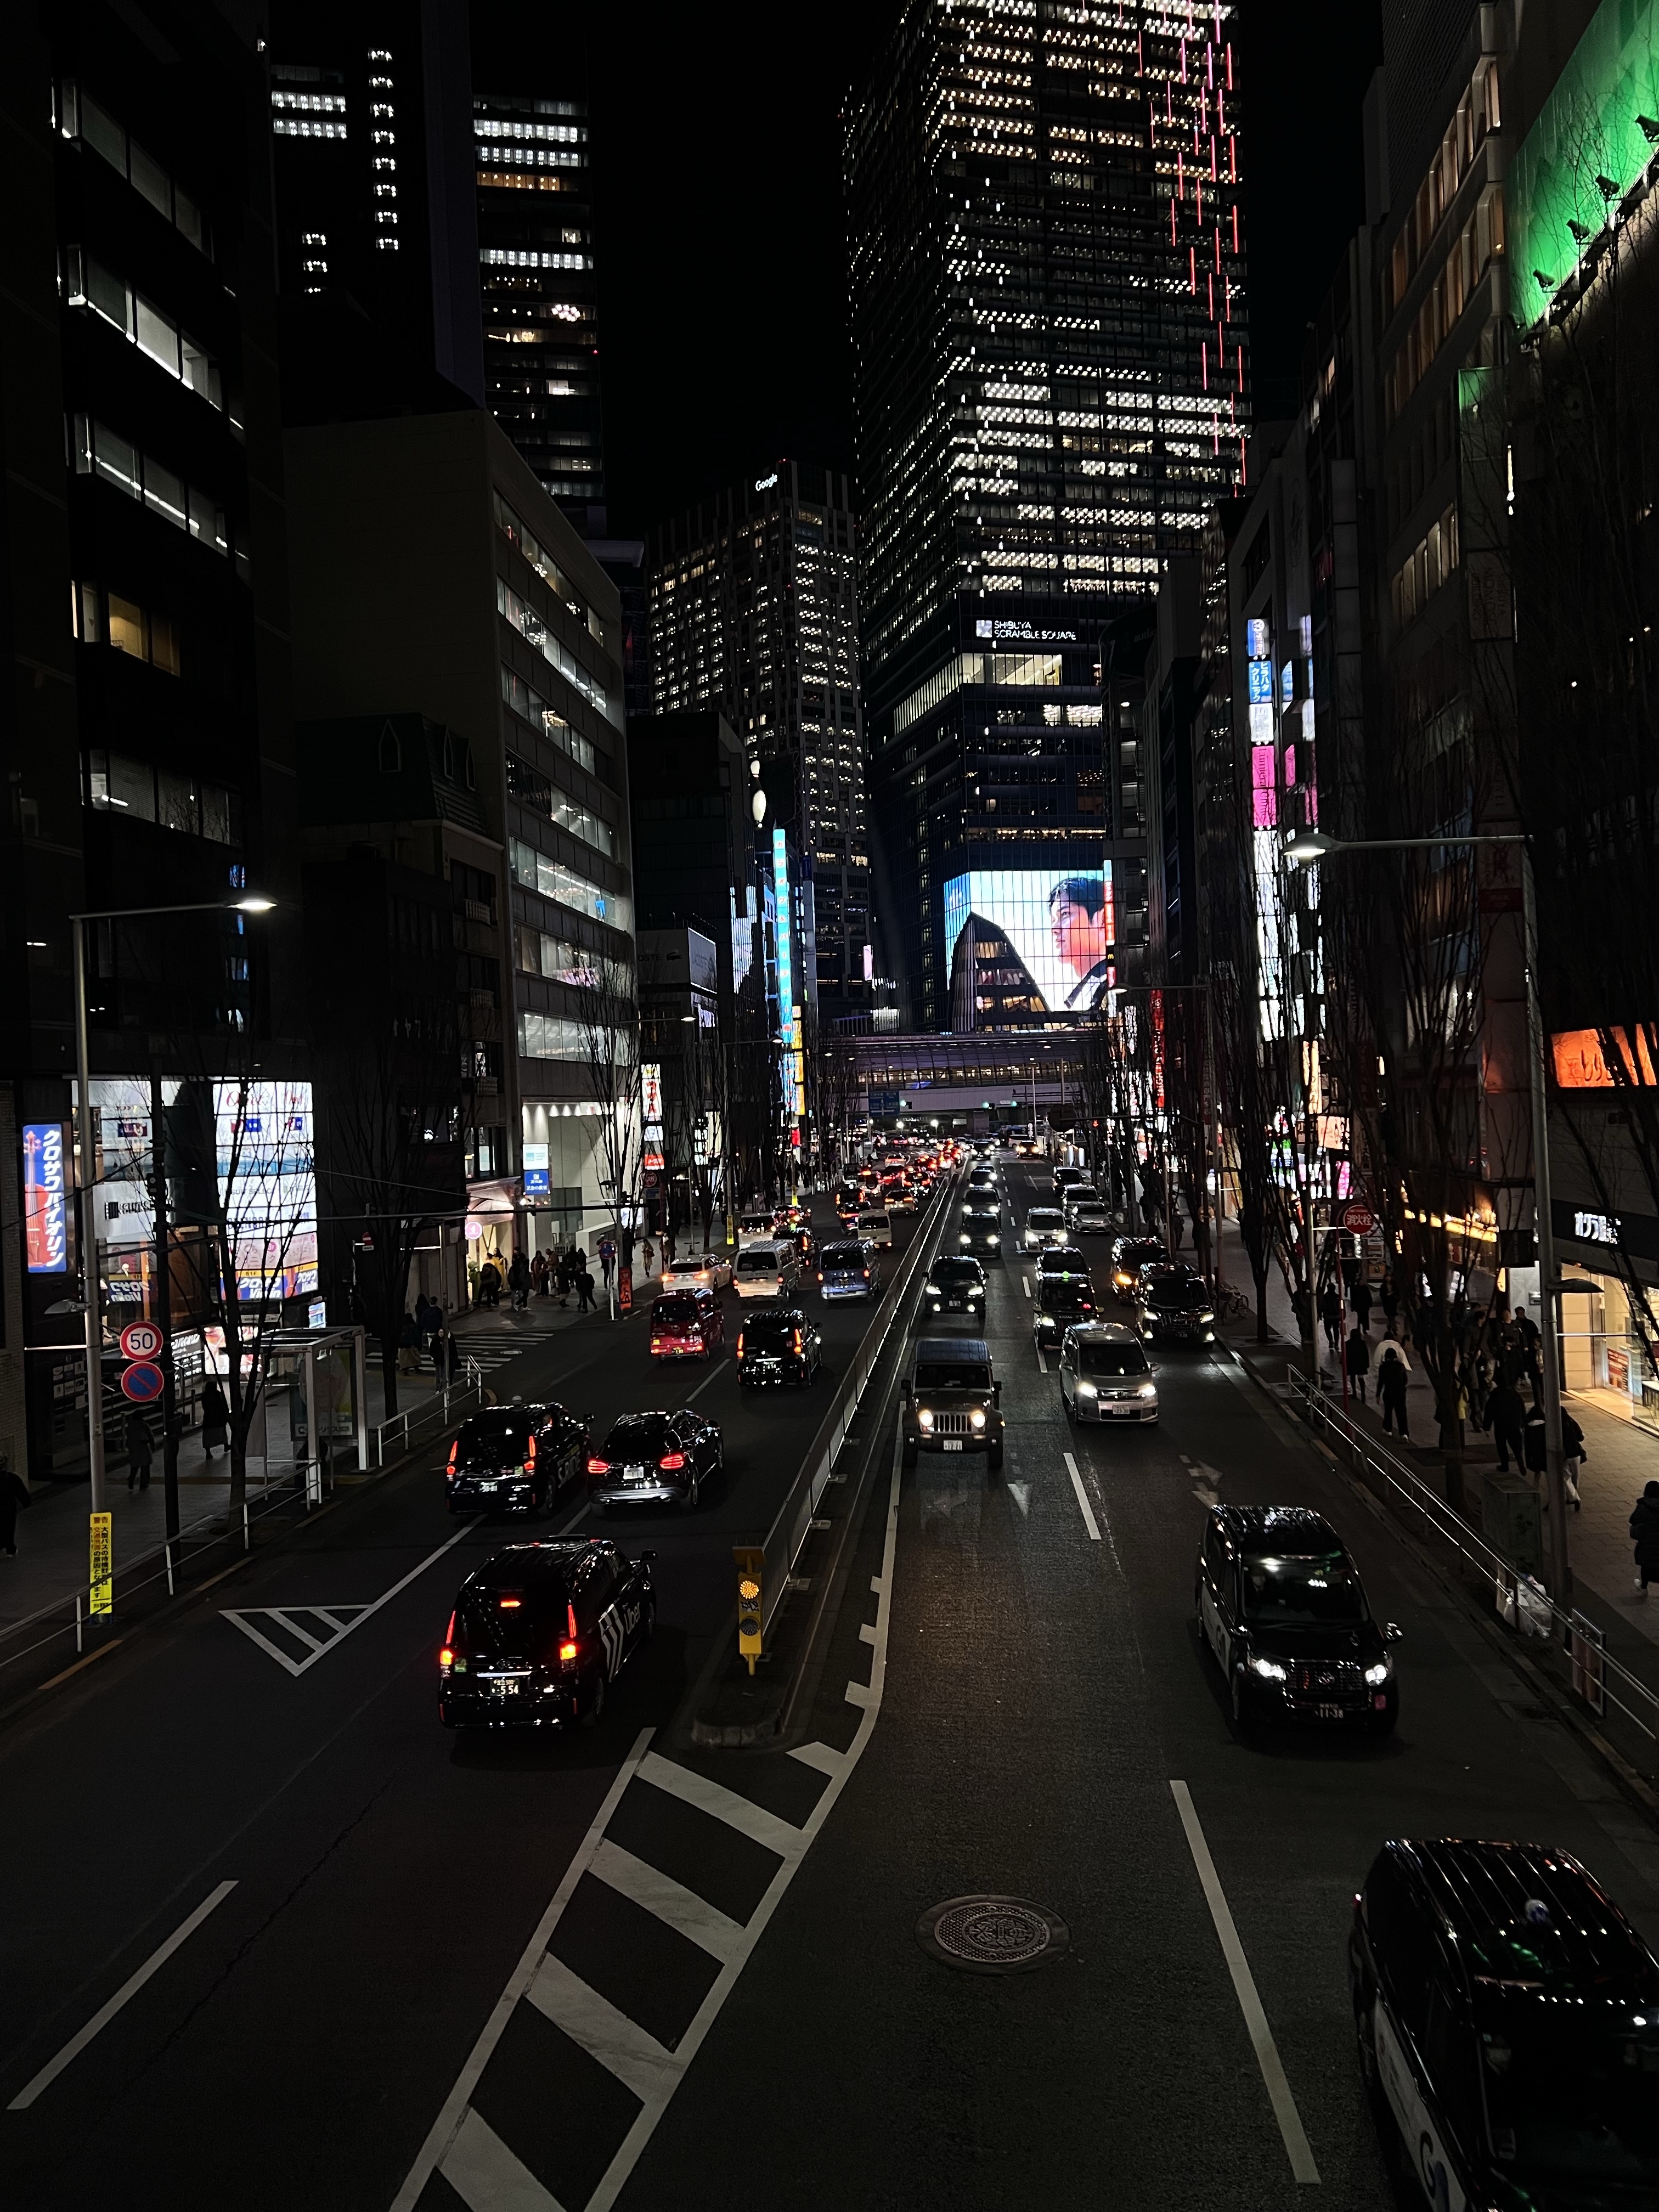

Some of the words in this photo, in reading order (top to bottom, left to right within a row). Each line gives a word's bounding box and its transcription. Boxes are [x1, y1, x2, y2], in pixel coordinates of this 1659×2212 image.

[755, 473, 778, 492] Google
[994, 620, 1032, 630] SHIBUYA
[994, 629, 1041, 639] SCRAMBLE
[1041, 630, 1076, 640] SQUARE
[1251, 668, 1261, 703] クリニック
[1260, 662, 1270, 692] ヒラハタ
[42, 1130, 64, 1267] クロサワバイオリン
[1346, 1214, 1373, 1226] 消火栓
[130, 1332, 154, 1350] 50
[623, 1601, 641, 1635] Uber
